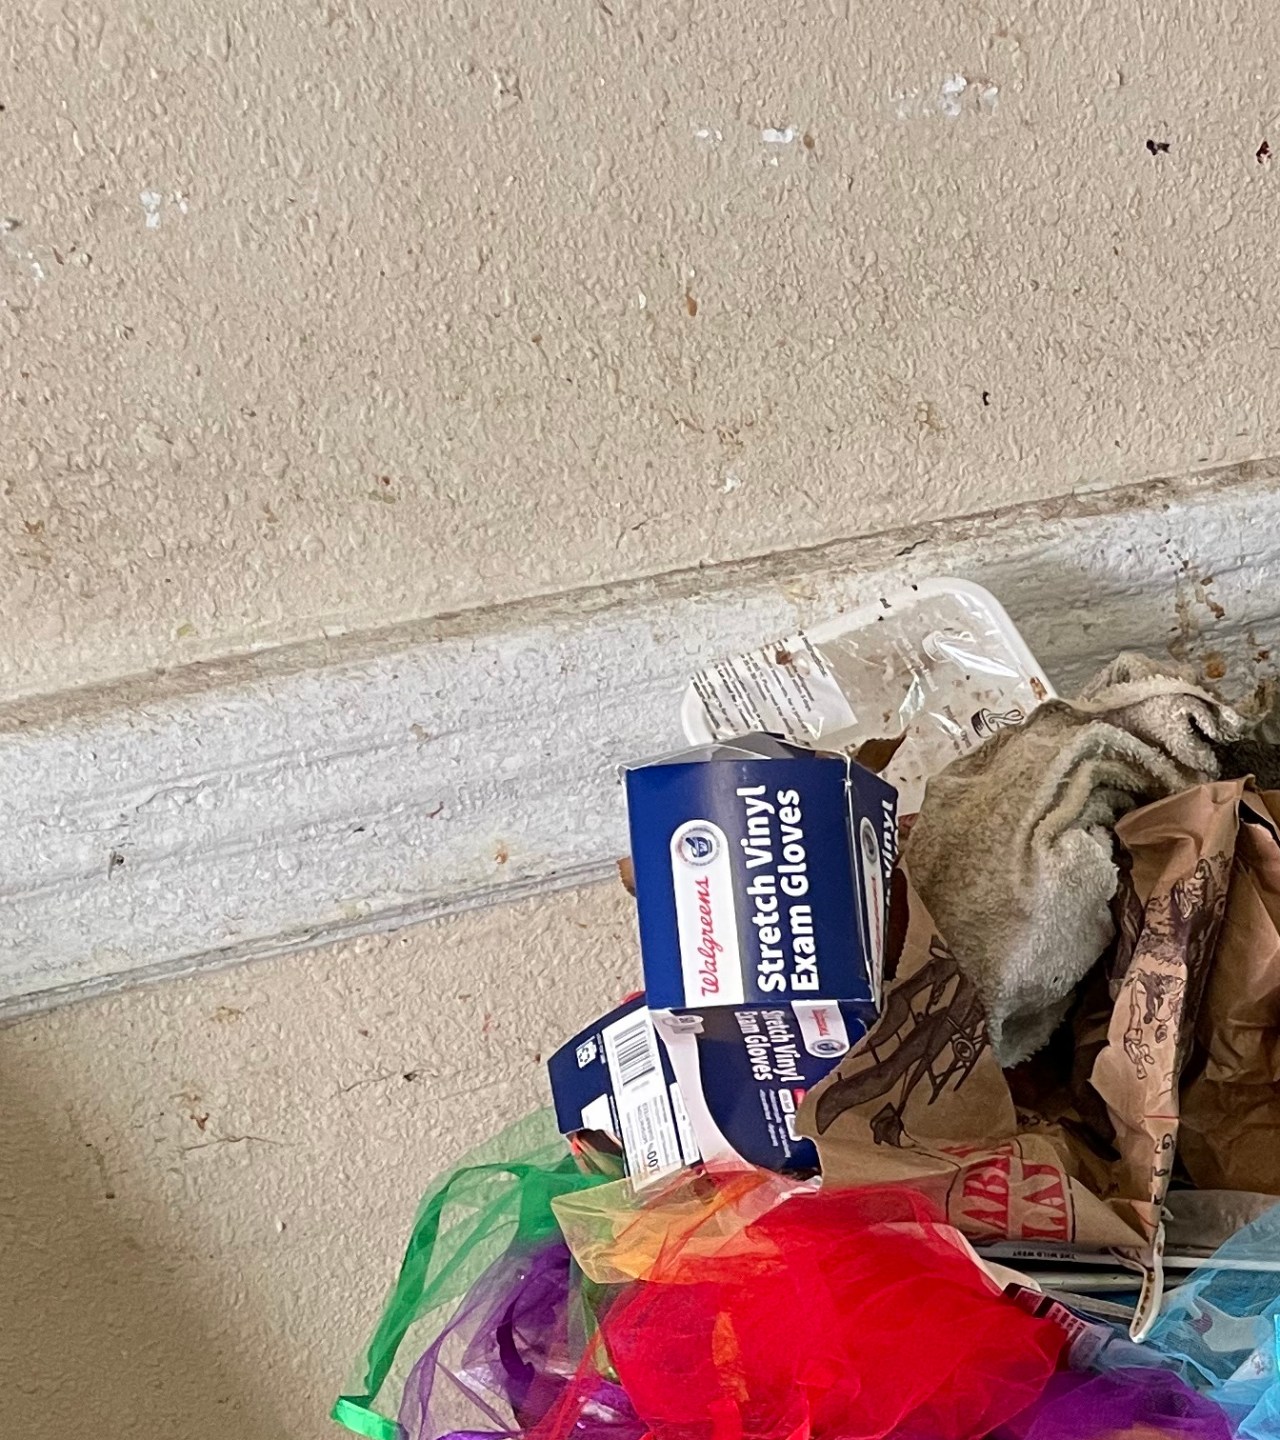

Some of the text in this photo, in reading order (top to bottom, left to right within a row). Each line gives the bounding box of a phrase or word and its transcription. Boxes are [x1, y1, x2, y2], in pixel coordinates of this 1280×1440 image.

[699, 876, 722, 996] Walgreens
[738, 785, 786, 992] Stretch Vinyl
[778, 791, 820, 991] Exam Gloves
[734, 1010, 773, 1081] Exam Gloves
[761, 1008, 794, 1043] Stretch
[771, 1044, 805, 1082] Vinyl
